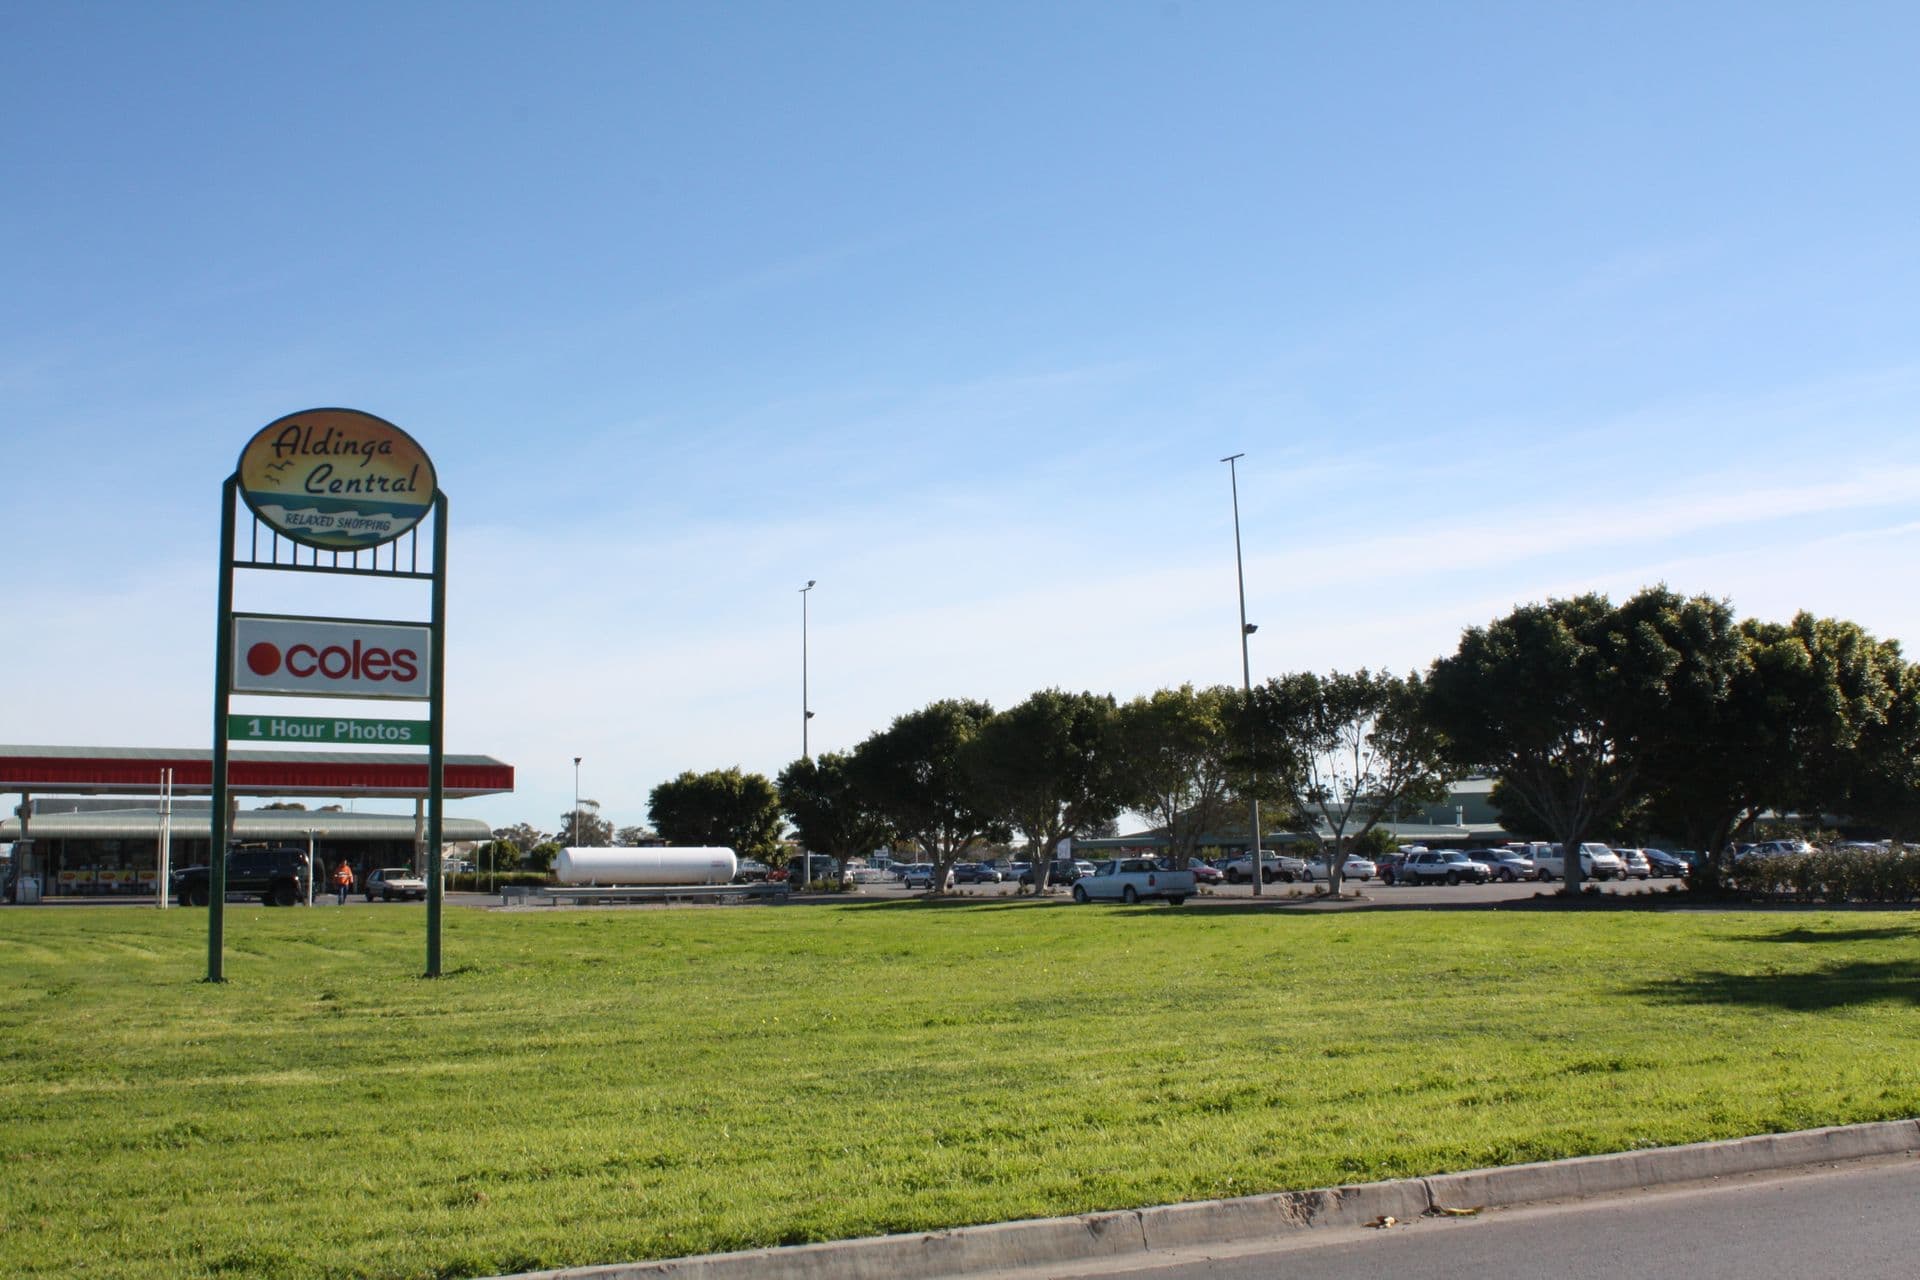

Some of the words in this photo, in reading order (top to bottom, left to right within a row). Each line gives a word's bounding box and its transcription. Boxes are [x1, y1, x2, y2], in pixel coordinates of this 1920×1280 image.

[271, 425, 393, 467] Aldinga
[304, 463, 420, 494] Central
[285, 512, 335, 527] RELAXED
[337, 516, 391, 531] SHOPPING
[285, 639, 418, 683] coles
[248, 719, 263, 737] 1
[270, 719, 325, 738] Hour
[334, 721, 412, 741] Photos
